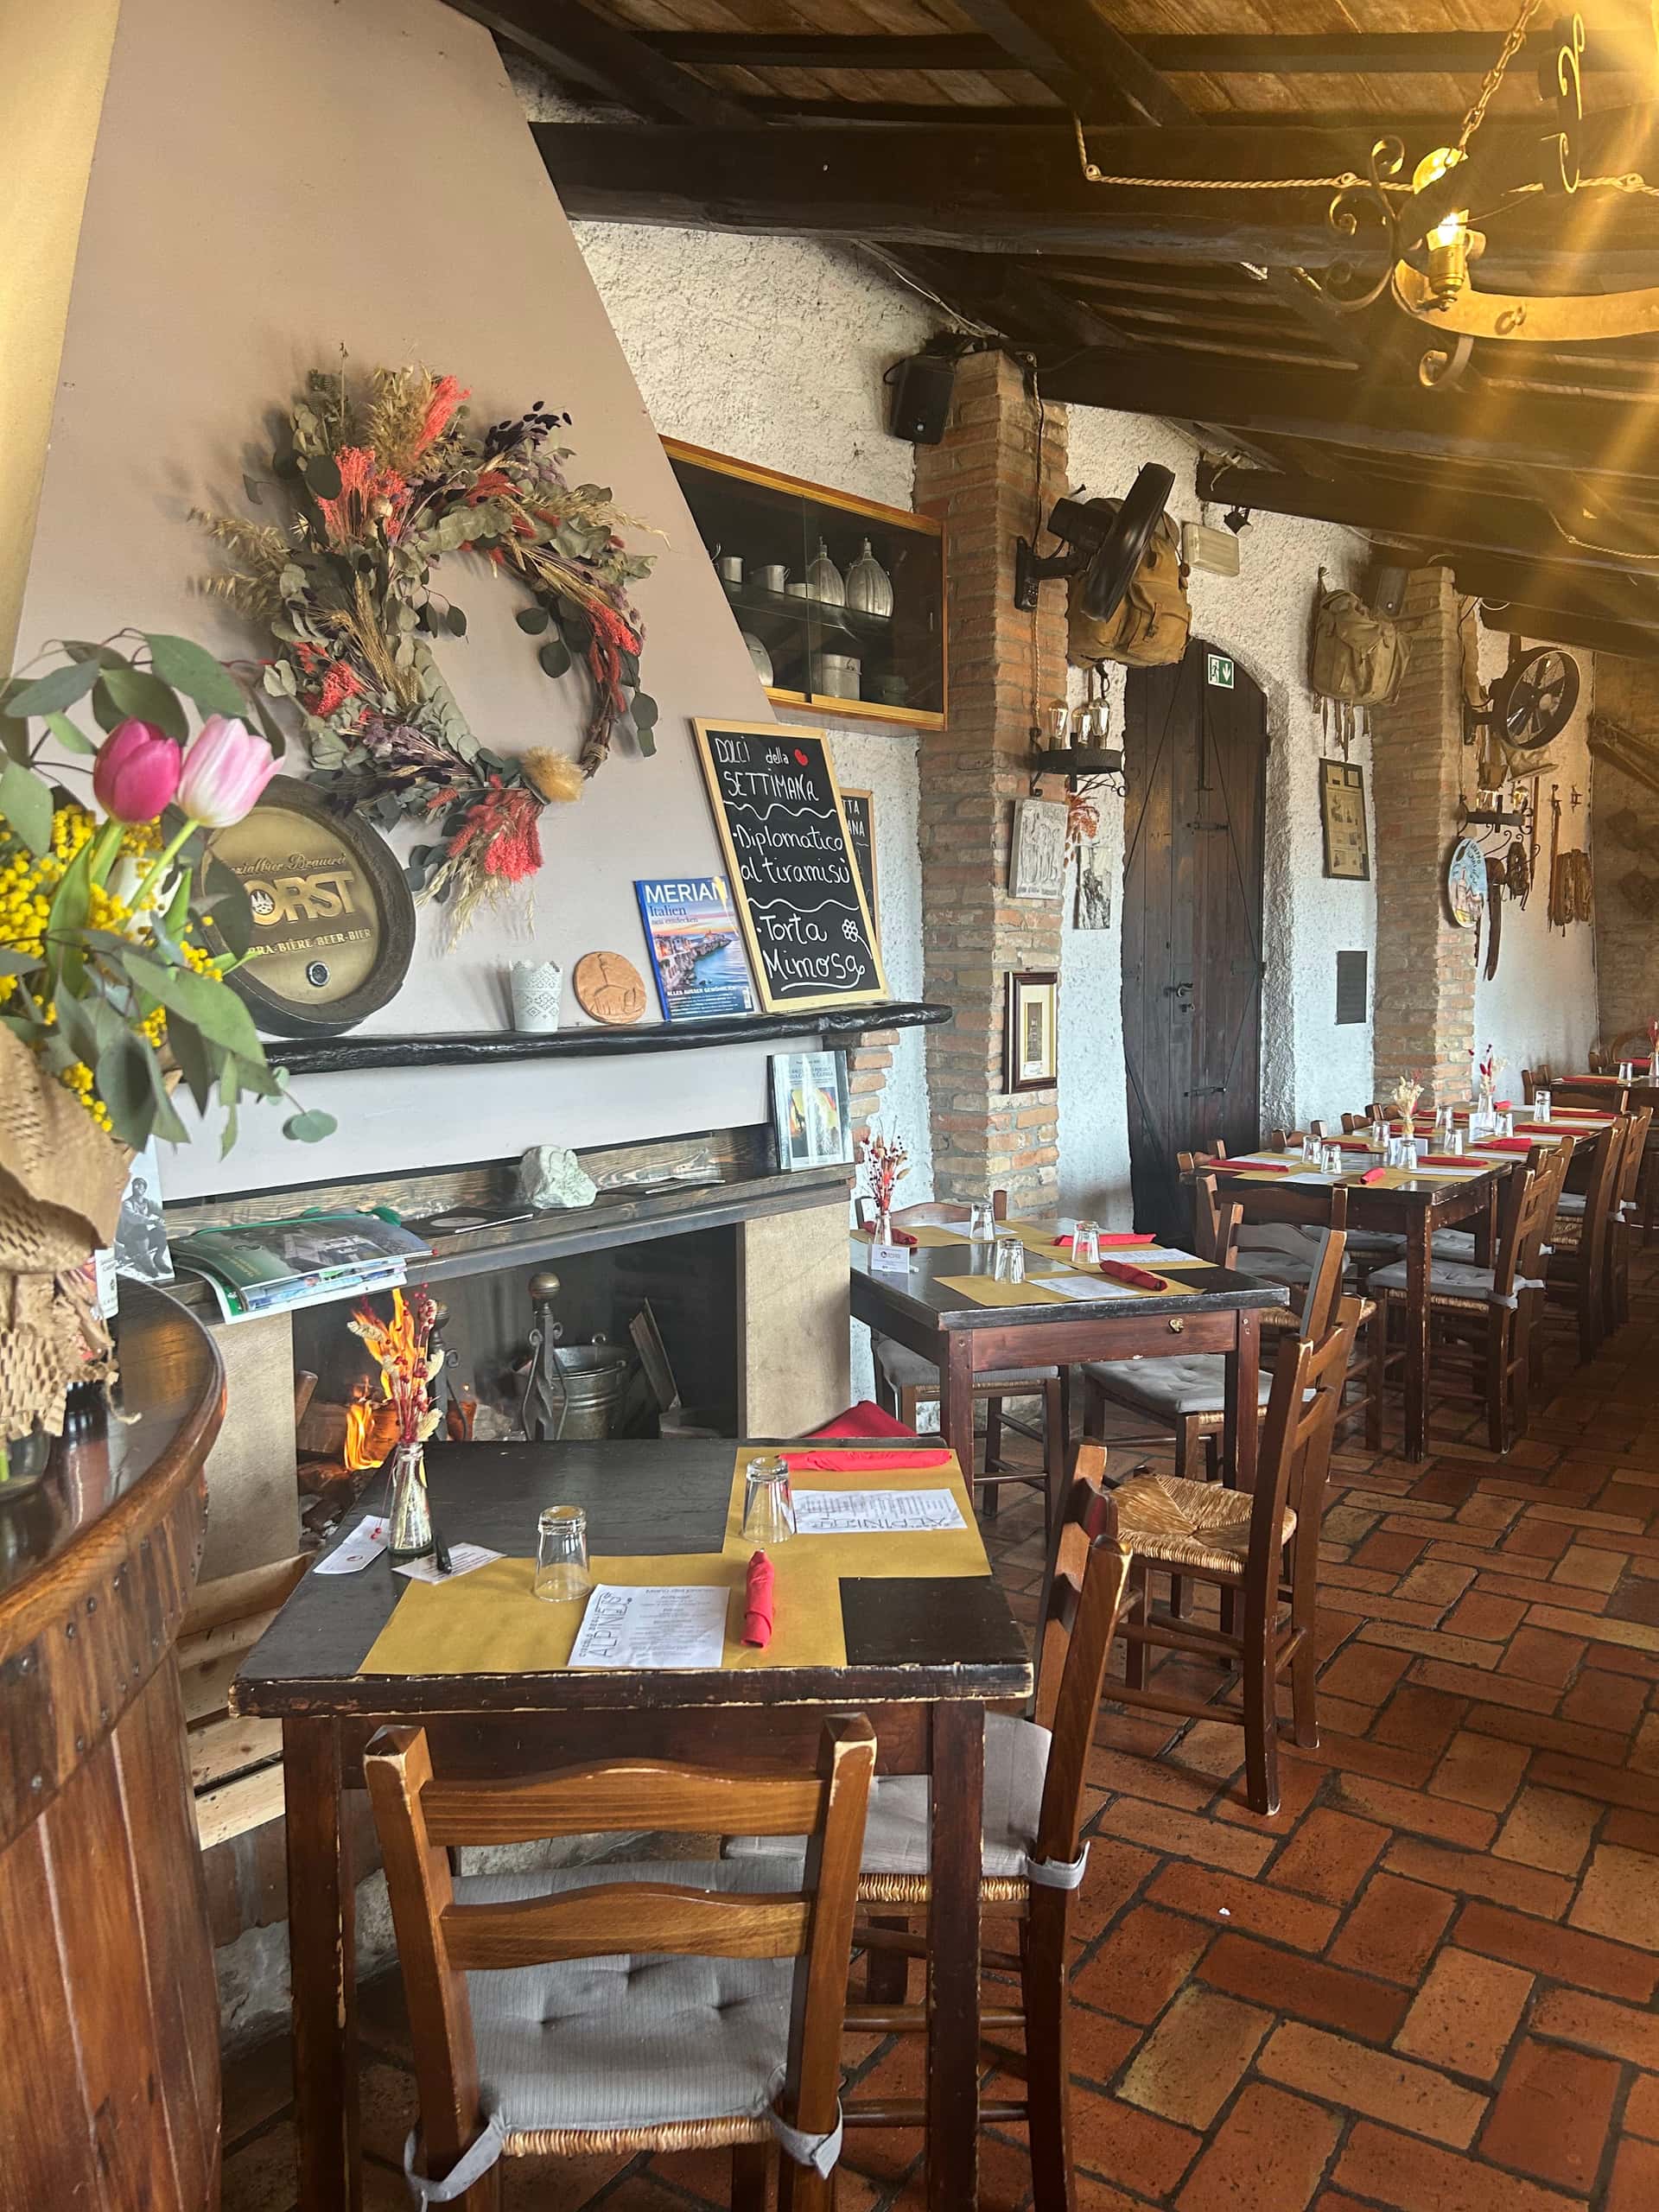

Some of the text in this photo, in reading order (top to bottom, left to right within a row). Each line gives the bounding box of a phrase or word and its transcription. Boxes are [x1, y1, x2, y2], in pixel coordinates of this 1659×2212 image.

[766, 746, 790, 765] della
[723, 768, 819, 802] SETTIMANA
[735, 823, 844, 855] Diplomatico
[741, 857, 851, 885] al tiramisù
[243, 870, 354, 926] ORST
[645, 880, 729, 904] MERIAN
[649, 905, 687, 918] Italien
[760, 913, 827, 944] Torta
[763, 948, 865, 980] Mimosa
